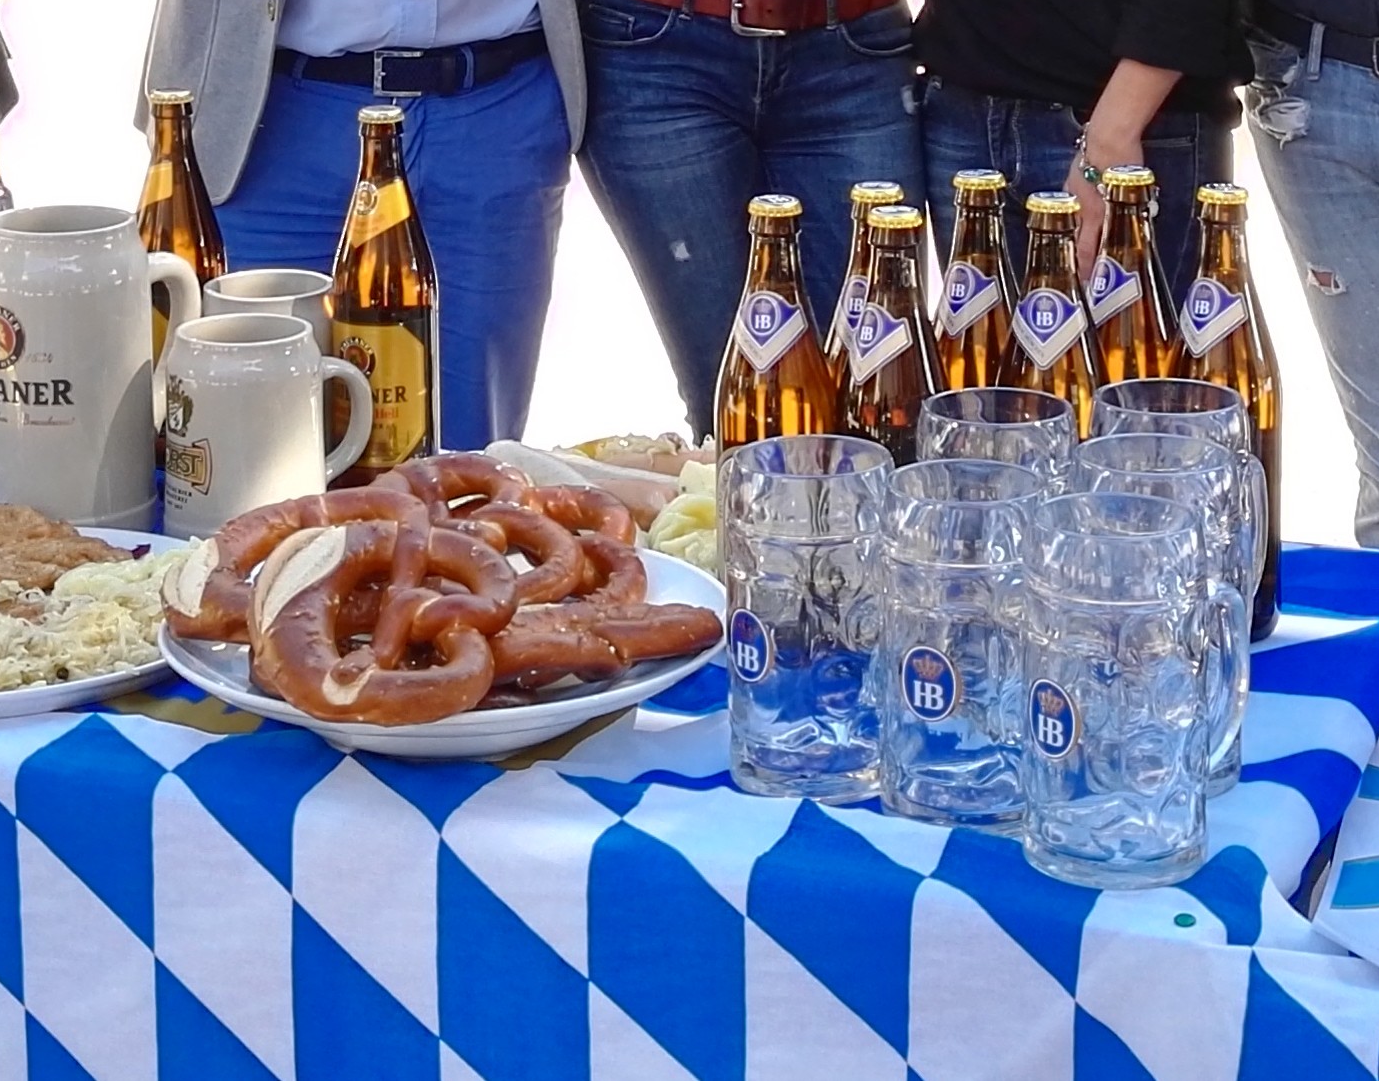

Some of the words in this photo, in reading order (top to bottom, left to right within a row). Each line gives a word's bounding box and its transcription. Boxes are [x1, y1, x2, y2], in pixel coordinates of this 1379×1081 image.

[952, 283, 966, 298] HB
[1094, 277, 1107, 292] HB
[849, 298, 864, 313] HB
[1195, 300, 1210, 315] HB
[755, 314, 772, 330] HB
[1036, 311, 1054, 327] HB
[860, 326, 874, 342] HB
[735, 640, 760, 673] HB
[913, 680, 945, 711] HB
[1037, 714, 1065, 748] HB
